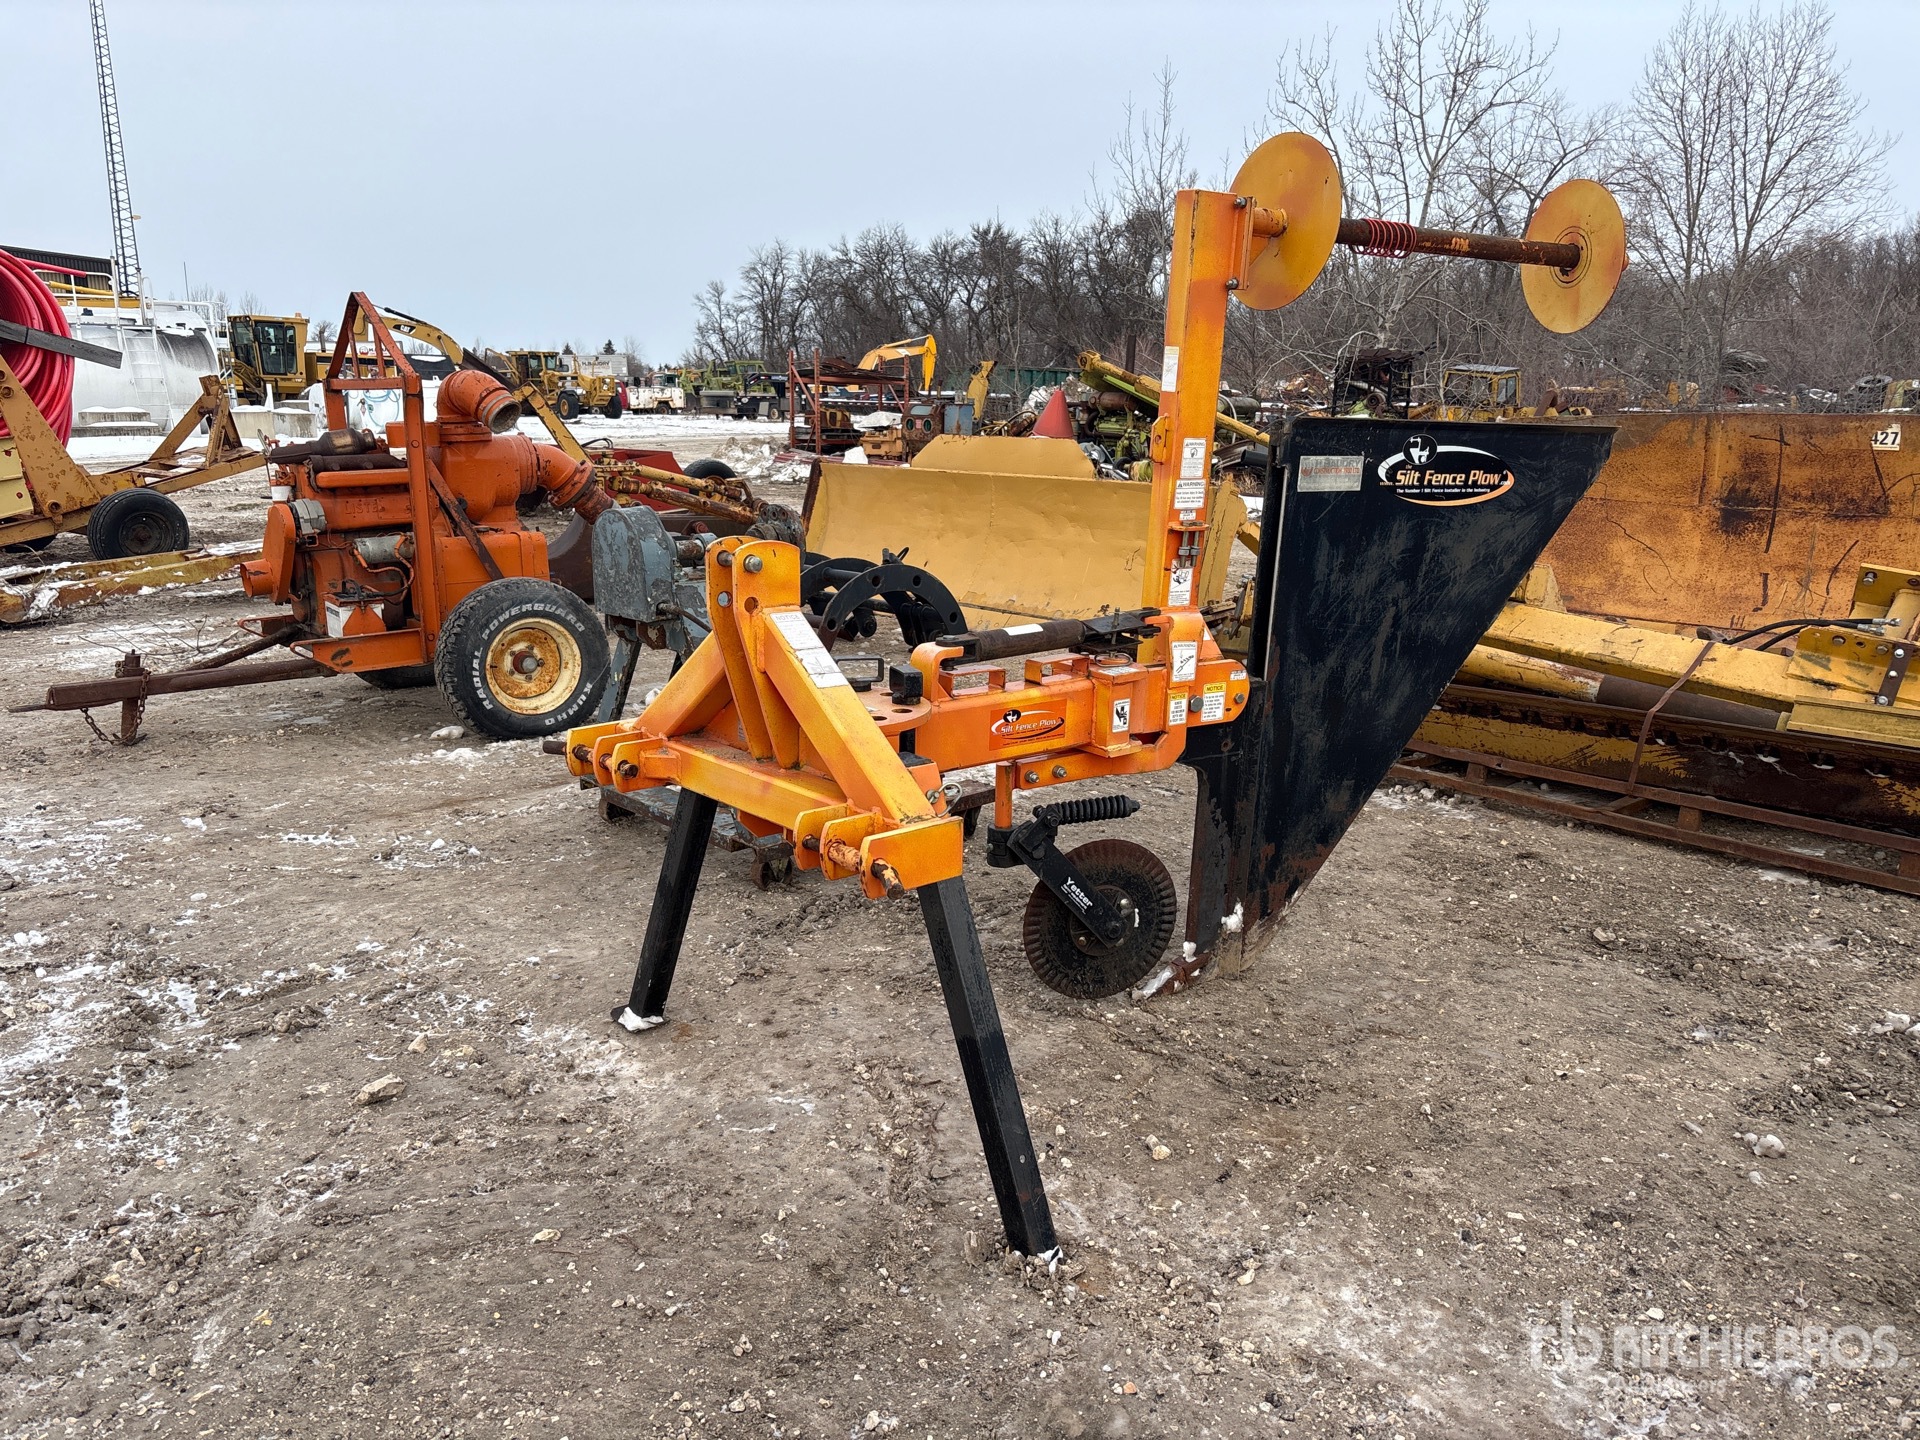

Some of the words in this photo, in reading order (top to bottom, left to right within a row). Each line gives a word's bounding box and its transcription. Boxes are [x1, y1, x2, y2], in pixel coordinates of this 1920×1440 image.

[1395, 470, 1421, 485] Silt
[1423, 470, 1466, 485] Fence
[1468, 470, 1501, 485] Plow
[482, 602, 586, 641] POWERGUARD
[472, 647, 494, 710] RADIAL
[545, 682, 593, 725] KUMHO
[1001, 726, 1013, 734] Silt
[1016, 723, 1038, 731] Fence
[1066, 876, 1093, 906] Yetter
